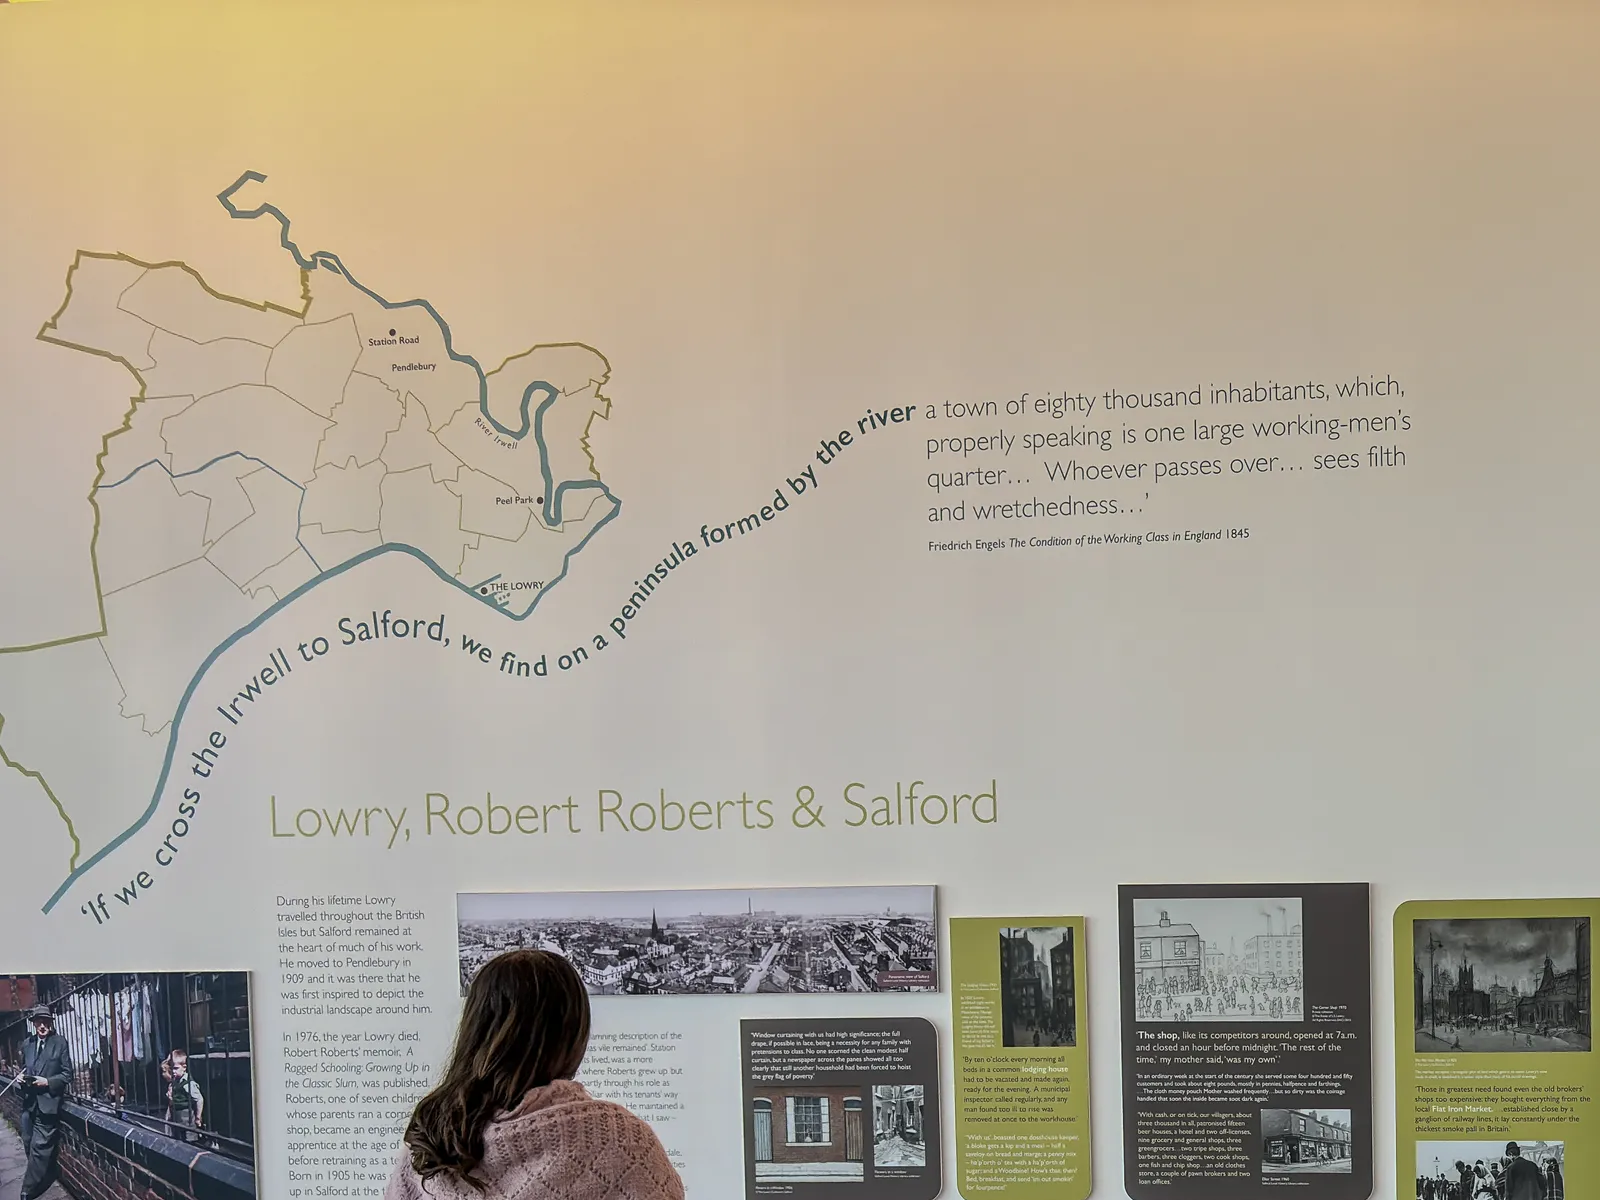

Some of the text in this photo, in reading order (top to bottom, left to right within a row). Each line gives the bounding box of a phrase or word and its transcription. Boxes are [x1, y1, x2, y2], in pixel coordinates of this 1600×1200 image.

[368, 335, 420, 347] Station Road
[391, 362, 437, 372] Pendlebury
[925, 375, 1404, 420] a town of eighty thousand inhabitants, which,
[474, 418, 518, 449] River Irwell
[928, 429, 1015, 459] properly
[1024, 425, 1112, 454] speaking
[1123, 423, 1136, 443] is
[1144, 426, 1185, 443] one
[1194, 420, 1244, 445] large
[1044, 460, 1147, 481] Whoever
[1155, 460, 1221, 483] passes
[1313, 453, 1360, 470] sees
[1368, 445, 1405, 467] filth
[495, 495, 534, 506] Peel Park
[929, 500, 964, 522] and
[928, 527, 1251, 552] Friedrich Engels The Condition of the Working Class in England 1845
[490, 580, 545, 592] THE LOWRY
[114, 871, 153, 906] we
[156, 788, 200, 866] cross
[192, 731, 227, 778] the
[217, 648, 292, 725] Irwell
[298, 637, 329, 662] to
[338, 609, 450, 647] Salford,
[461, 634, 492, 663] we
[499, 652, 547, 677] find
[558, 646, 589, 670] on
[592, 634, 609, 651] a
[609, 540, 698, 639] peninsula
[700, 488, 789, 547] formed
[786, 464, 818, 495] by
[815, 430, 854, 465] the
[857, 404, 917, 435] river
[271, 779, 997, 849] Lowry, Robert Roberts & Salford
[276, 894, 397, 909] During his lifetime Lowry
[276, 909, 425, 924] travelled throughout the British
[1156, 1030, 1181, 1042] shop,
[1182, 1030, 1197, 1040] like
[1198, 1031, 1209, 1040] its
[1210, 1031, 1260, 1042] competitors
[1261, 1030, 1292, 1040] around,
[1292, 1030, 1324, 1042] opened
[1325, 1032, 1334, 1040] at
[1335, 1030, 1358, 1040] 7a.m.
[1431, 1105, 1494, 1113] Flat Iron Market.
